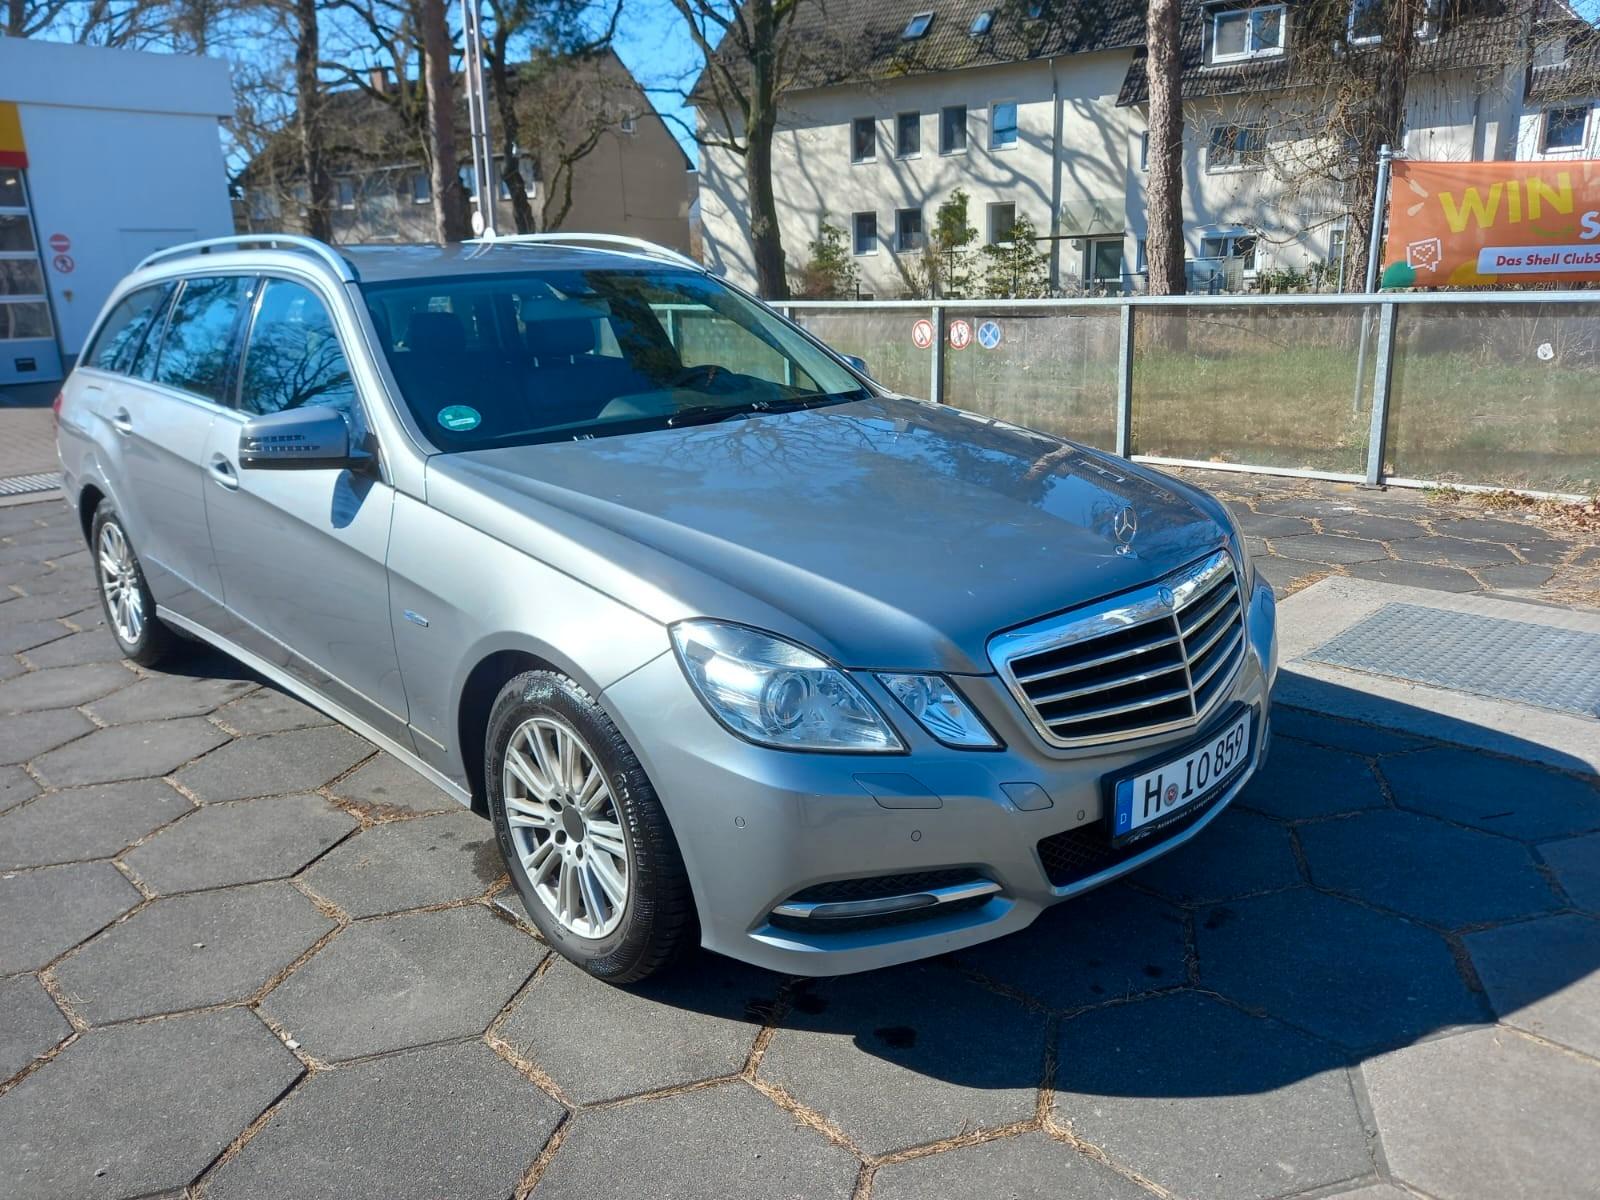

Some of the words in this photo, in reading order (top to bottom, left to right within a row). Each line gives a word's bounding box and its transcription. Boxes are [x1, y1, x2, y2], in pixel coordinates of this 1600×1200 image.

[1438, 171, 1574, 233] WIN
[1496, 255, 1522, 266] Das
[1526, 251, 1560, 265] Shell
[1143, 774, 1163, 818] H
[1214, 724, 1243, 777] 859
[1120, 813, 1127, 825] D
